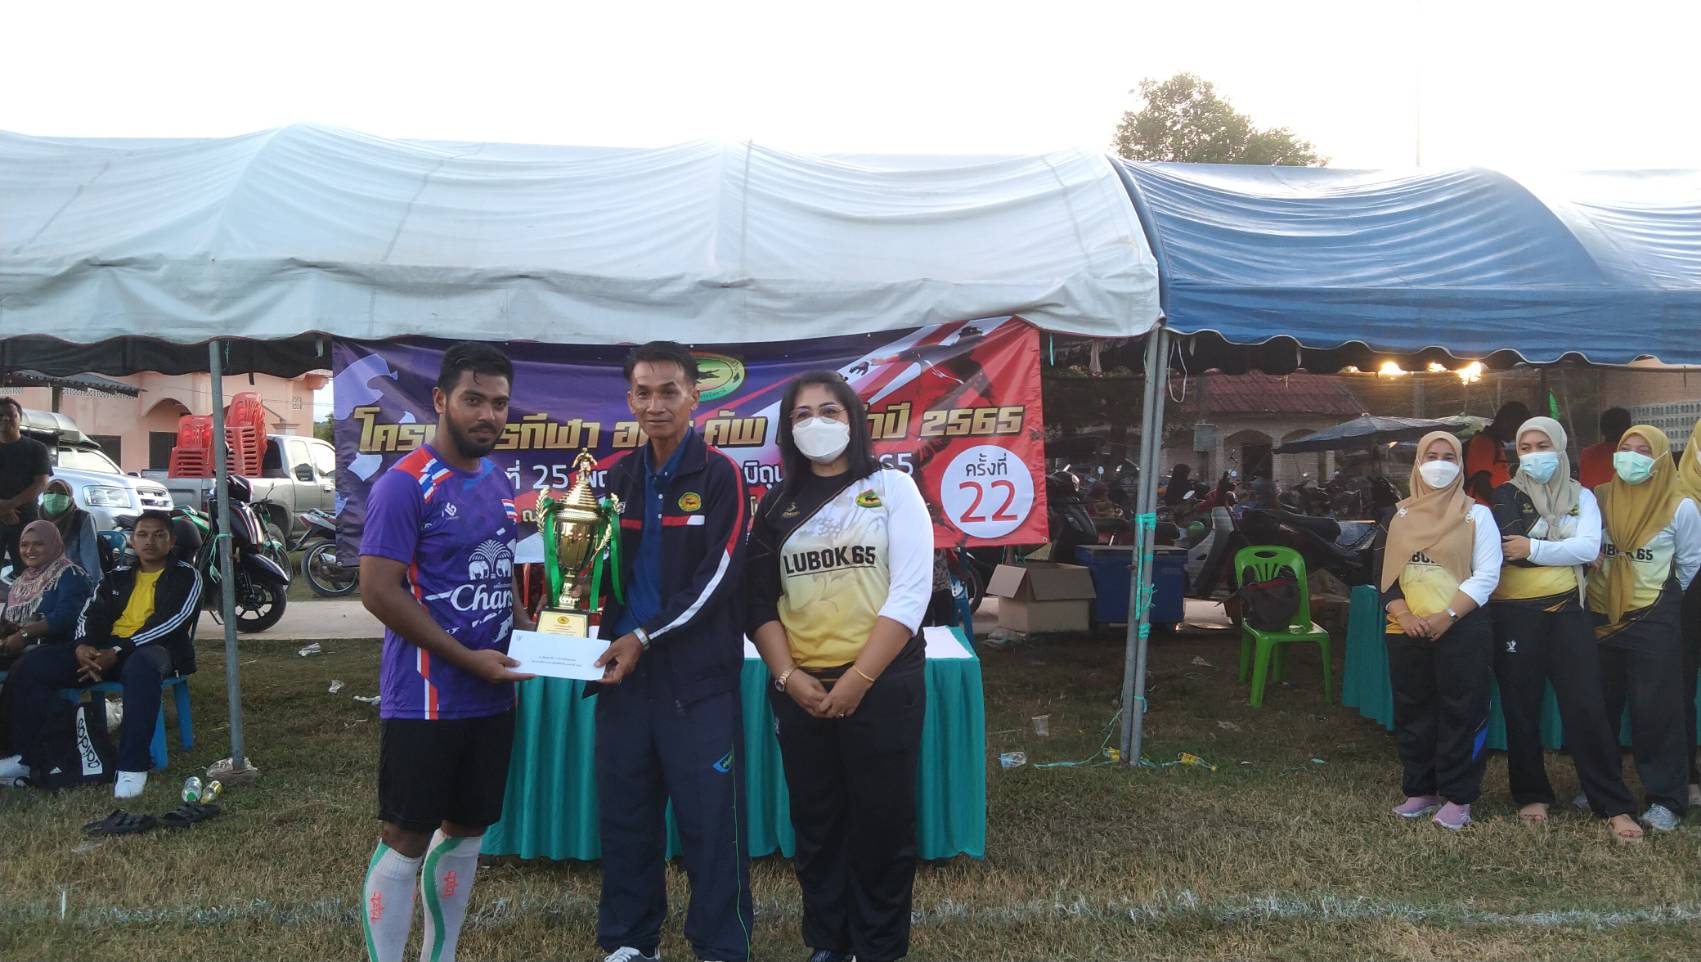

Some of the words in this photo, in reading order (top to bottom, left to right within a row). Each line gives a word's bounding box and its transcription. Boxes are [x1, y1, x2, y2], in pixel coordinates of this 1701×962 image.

[919, 405, 1025, 437] 2565
[532, 464, 569, 490] 25
[965, 452, 1008, 477] ครั้งที่
[958, 479, 1018, 523] 22
[783, 546, 850, 574] LUBOK
[852, 545, 877, 565] 65
[1636, 548, 1654, 561] 65
[450, 584, 513, 611] Chan
